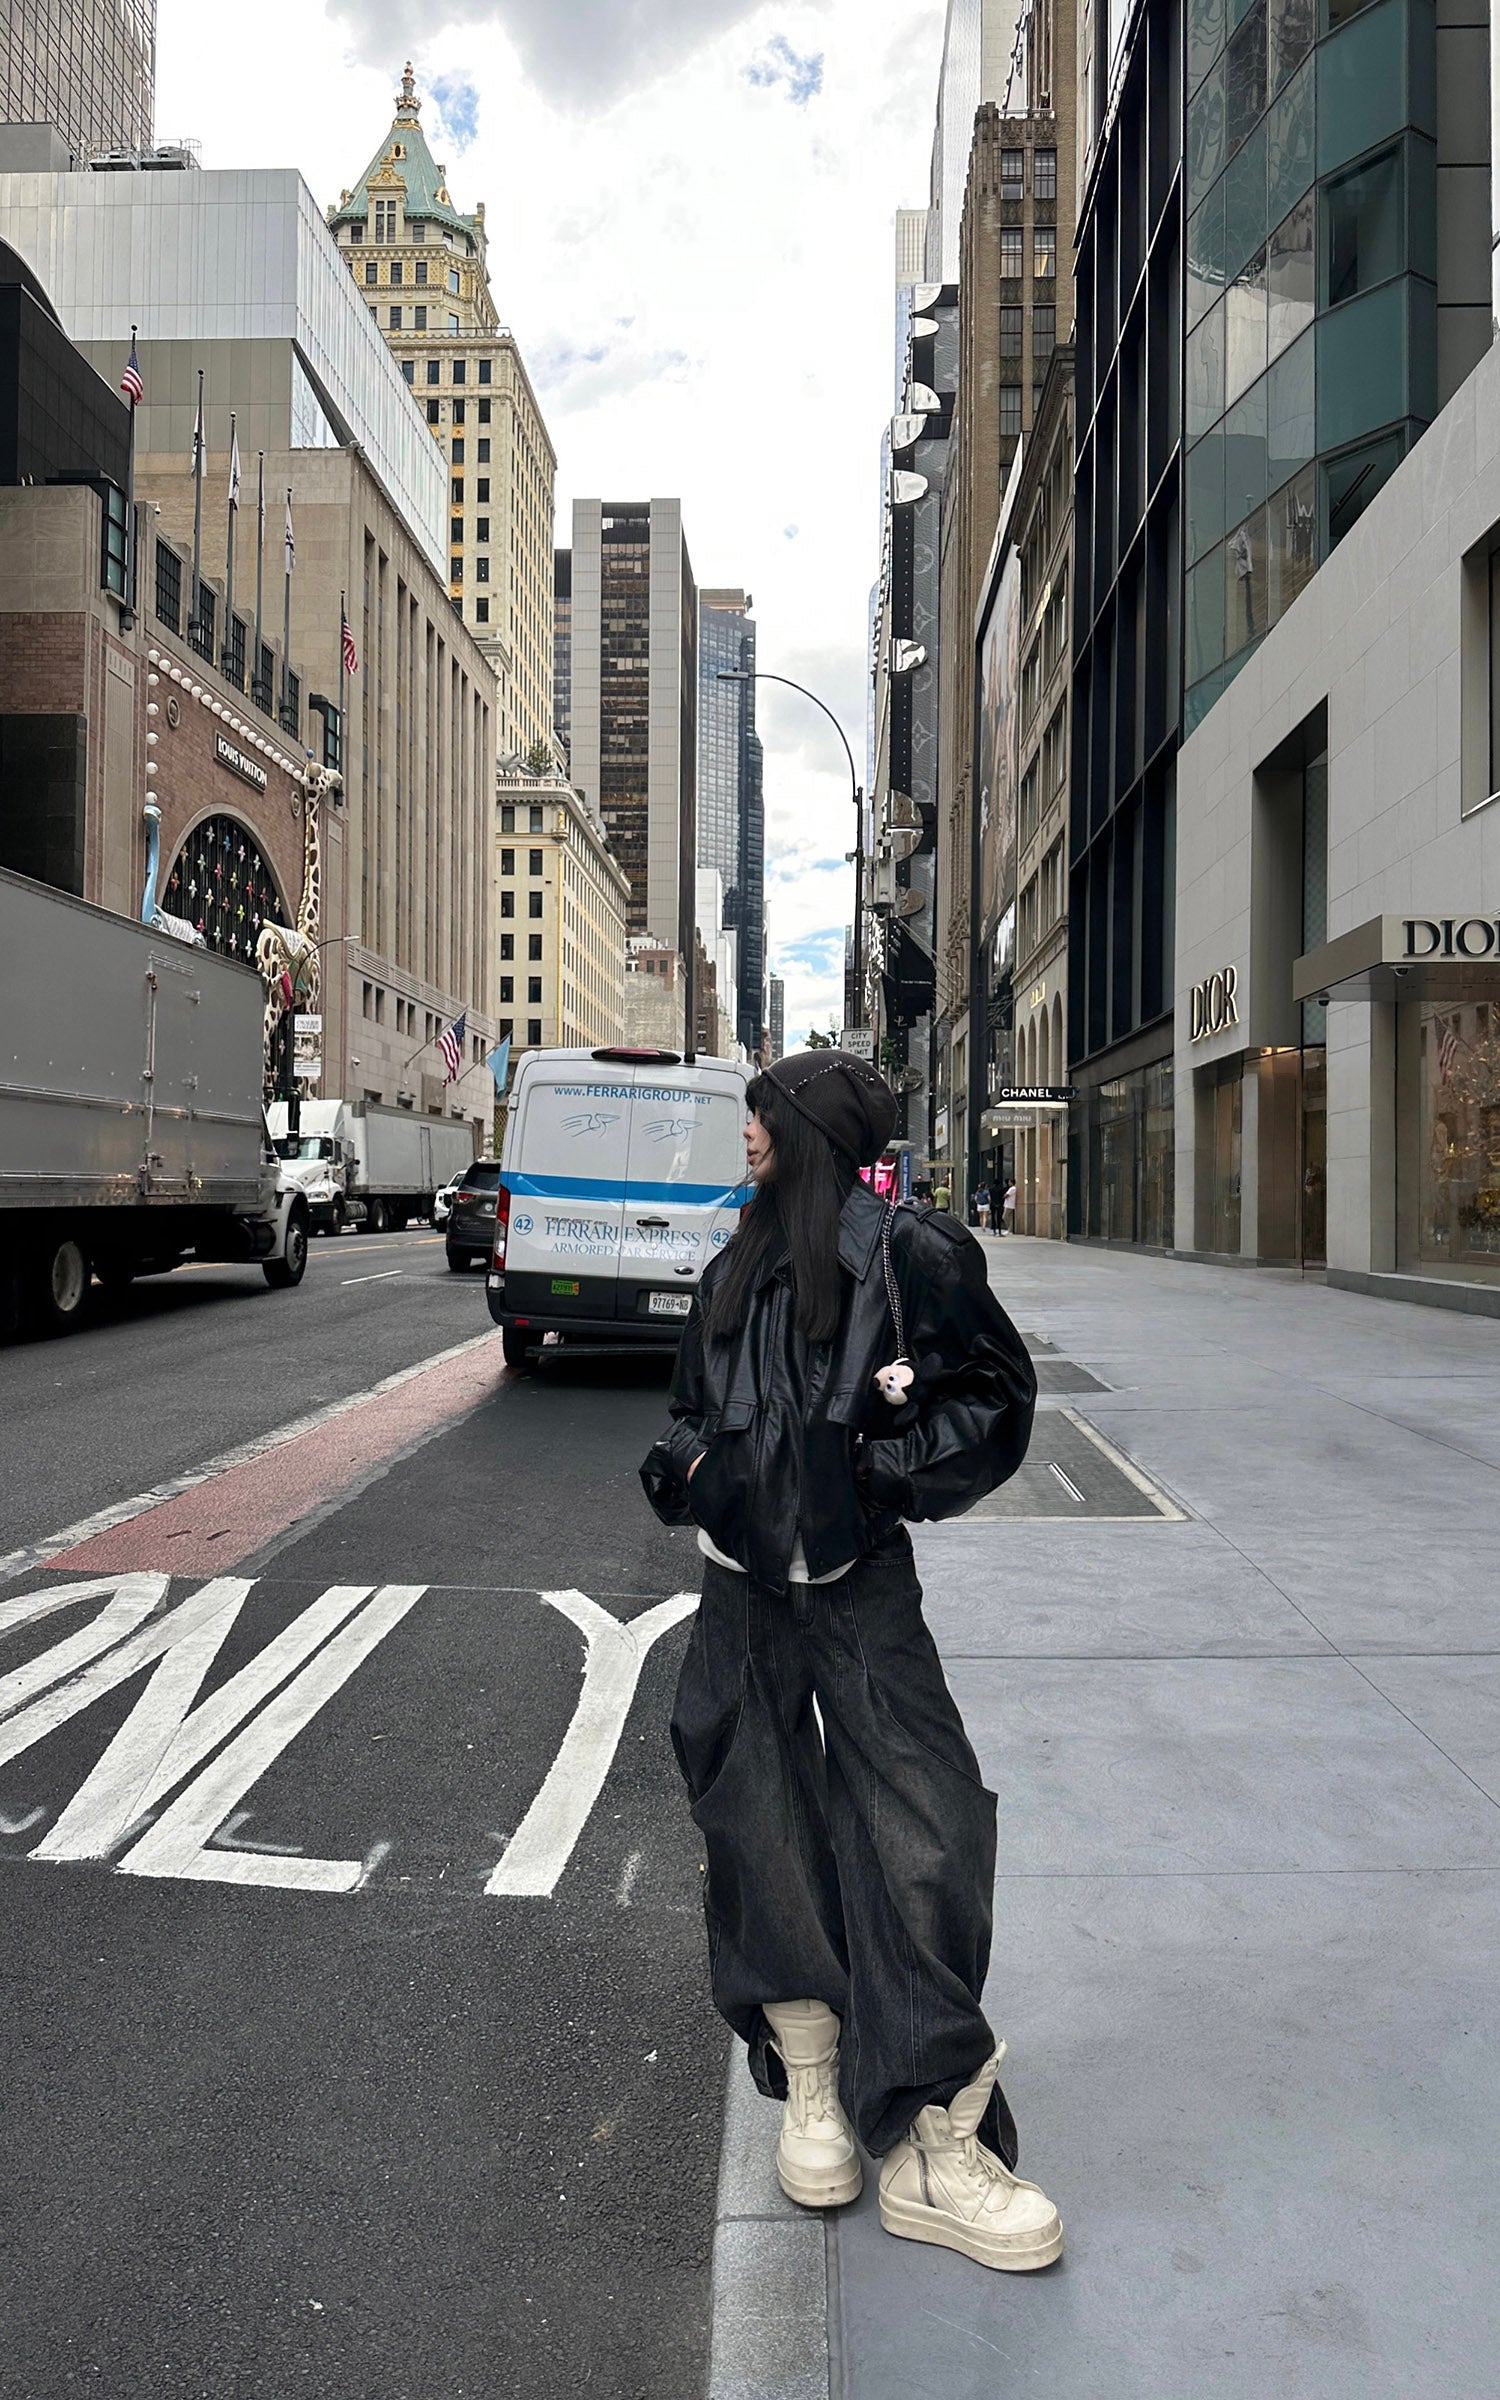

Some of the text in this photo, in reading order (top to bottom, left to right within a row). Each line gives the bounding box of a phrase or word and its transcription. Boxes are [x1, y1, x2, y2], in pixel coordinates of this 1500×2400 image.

[218, 738, 268, 786] LOUIS VUITTON
[1401, 918, 1500, 958] DIO
[1188, 965, 1240, 1043] DIOR
[1001, 1088, 1053, 1098] CHANEL
[515, 1219, 531, 1231] 42
[544, 1221, 700, 1249] FERRARI EXPRESS
[713, 1230, 731, 1244] 42
[551, 1242, 614, 1256] ARMORED
[645, 1248, 696, 1262] SERVICE
